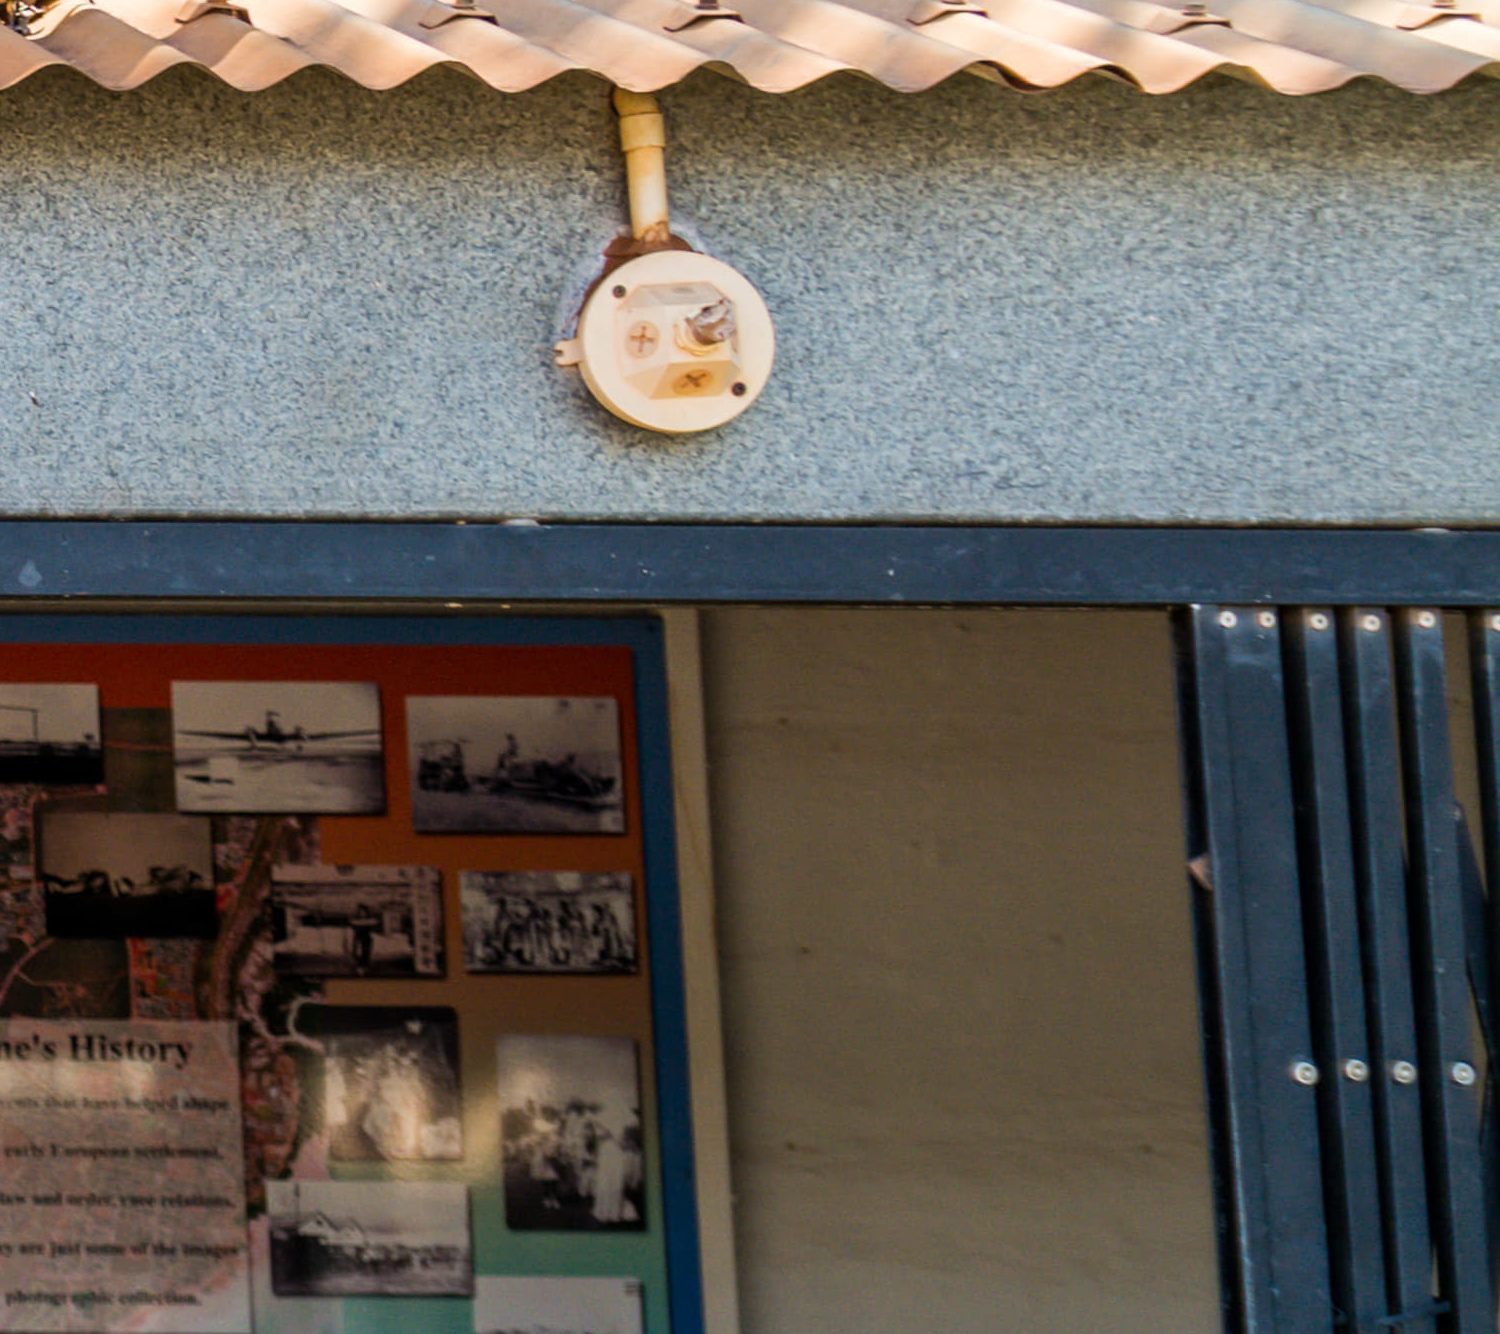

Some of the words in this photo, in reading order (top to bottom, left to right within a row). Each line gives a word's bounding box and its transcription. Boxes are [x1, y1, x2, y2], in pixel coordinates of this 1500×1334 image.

[69, 1034, 193, 1069] History
[32, 1192, 62, 1206] and
[19, 1244, 44, 1255] are
[49, 1242, 81, 1258] just
[85, 1244, 125, 1256] some
[129, 1242, 148, 1256] of
[152, 1243, 177, 1256] the
[4, 1290, 112, 1307] photographic
[118, 1291, 202, 1307] collection.
